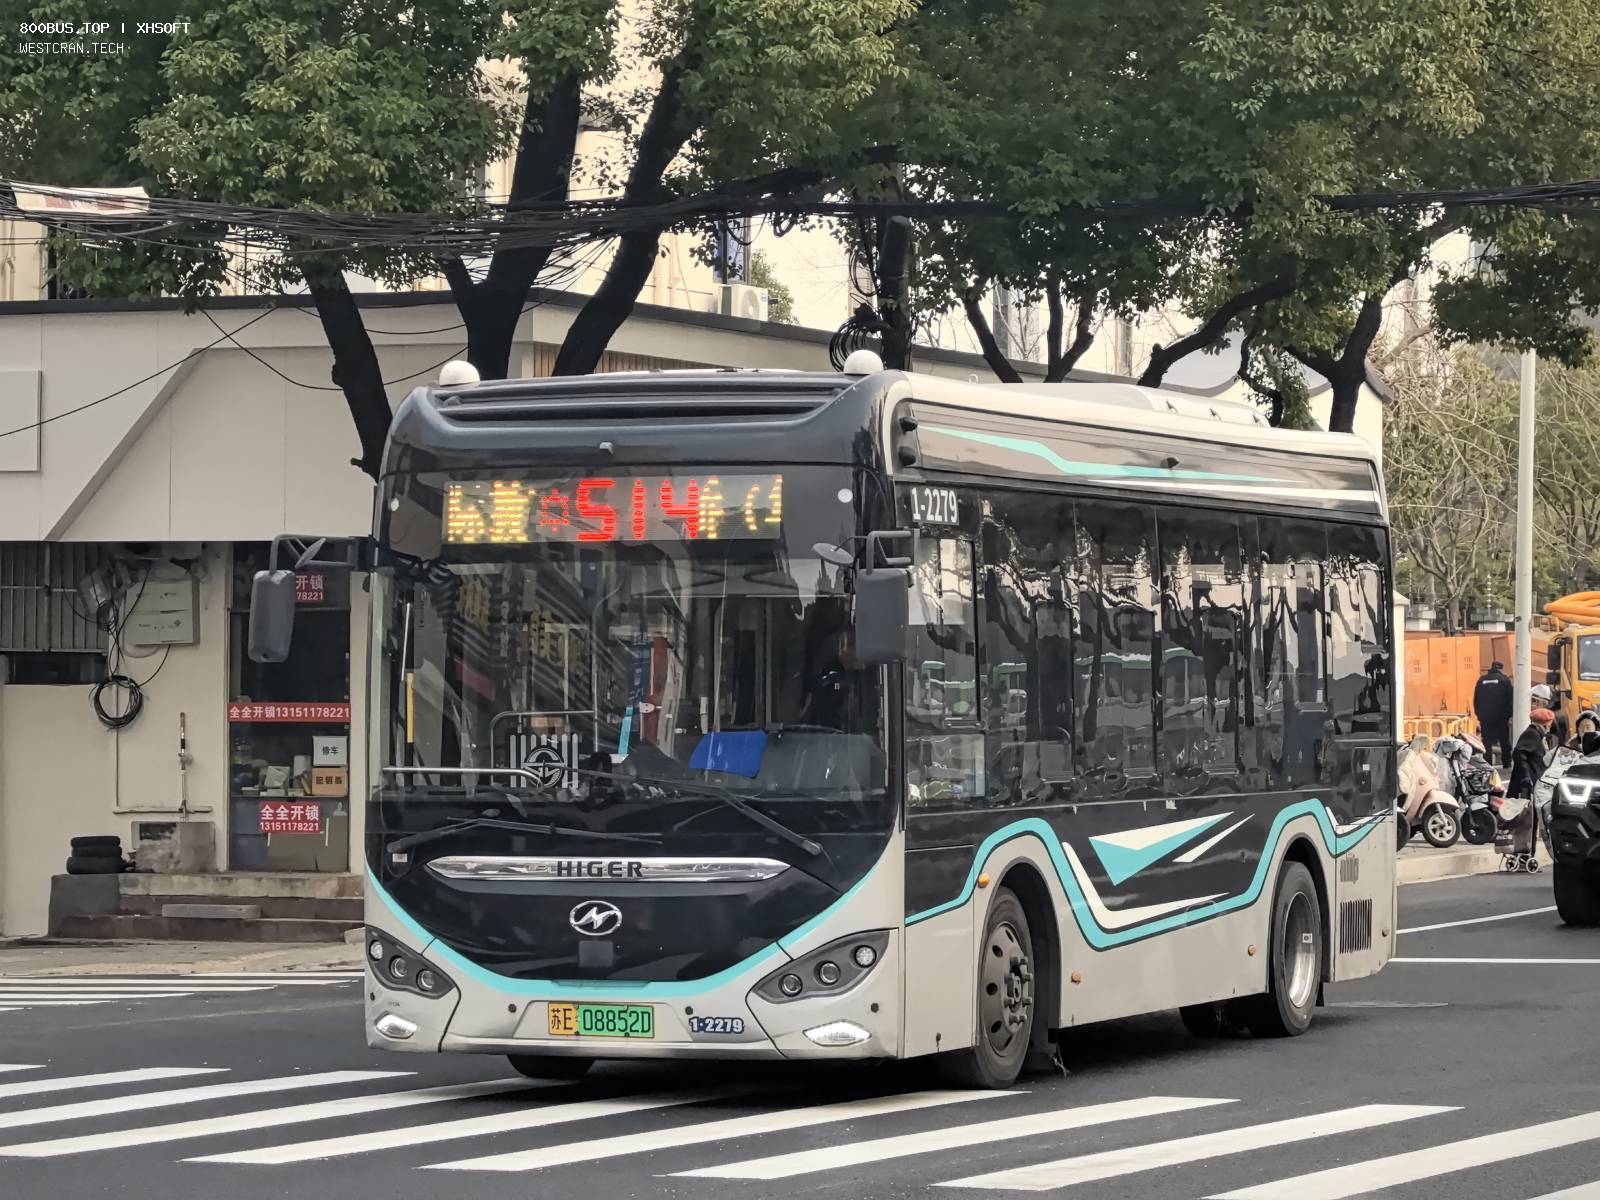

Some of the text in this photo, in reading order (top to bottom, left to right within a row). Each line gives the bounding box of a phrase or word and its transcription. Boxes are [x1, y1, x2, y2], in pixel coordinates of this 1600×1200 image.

[576, 478, 699, 542] 514
[911, 487, 958, 523] 1-2279
[260, 804, 320, 821] 全全开锁
[259, 822, 320, 831] 13151178221
[557, 860, 643, 878] HIGER
[582, 1009, 651, 1033] 08852D
